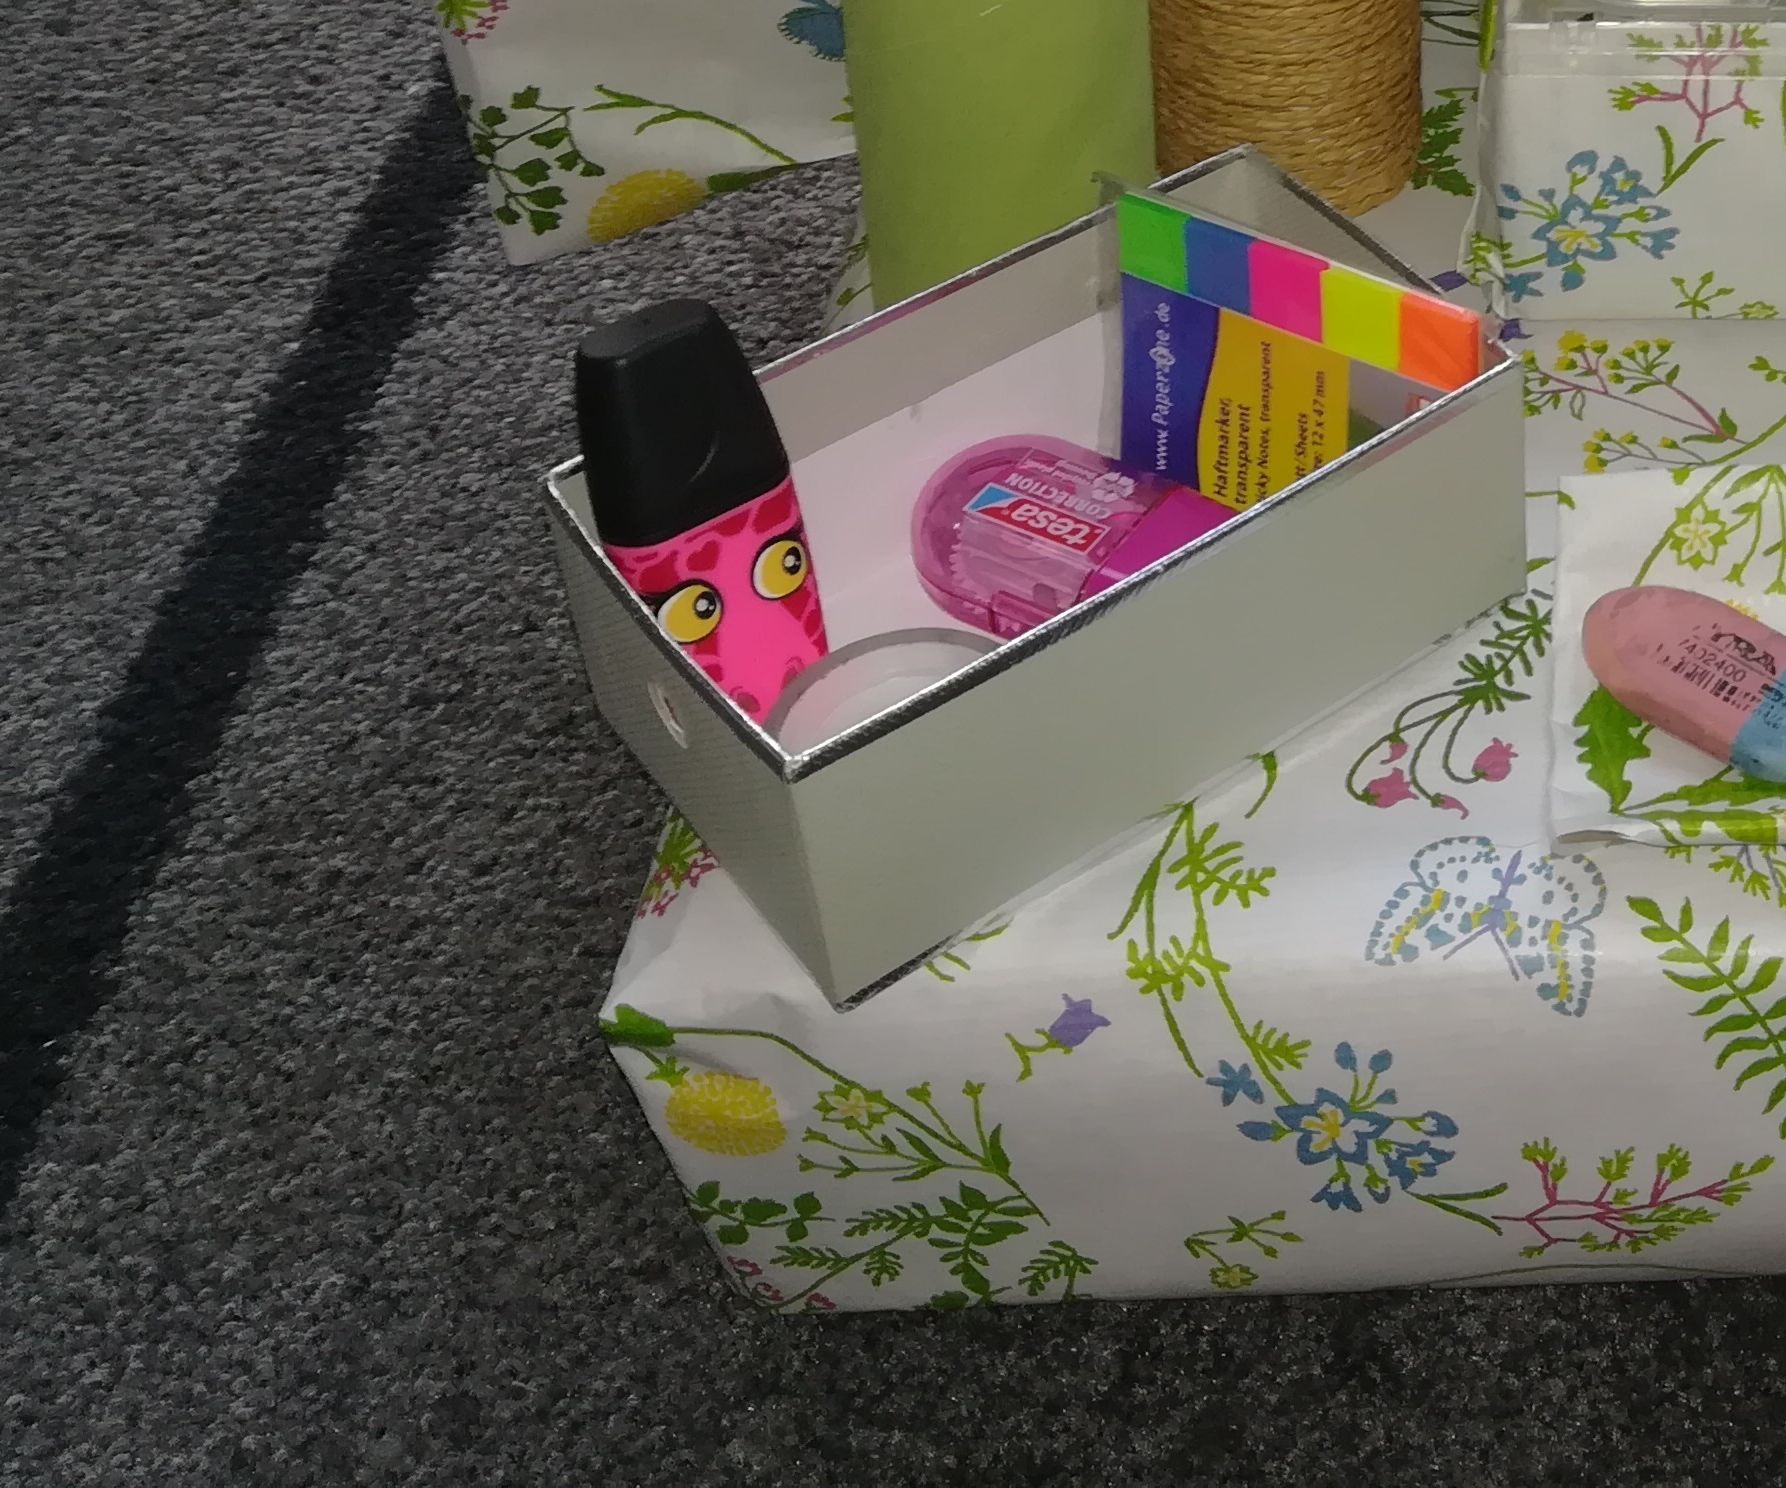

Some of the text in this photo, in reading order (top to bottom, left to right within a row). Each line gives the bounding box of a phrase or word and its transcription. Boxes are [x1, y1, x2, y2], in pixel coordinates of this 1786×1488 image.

[1258, 340, 1274, 423] transparent
[1213, 397, 1232, 499] Haftmarker,
[1235, 403, 1252, 505] transparent
[1005, 472, 1113, 521] CORRECTION
[1010, 503, 1090, 545] tesa
